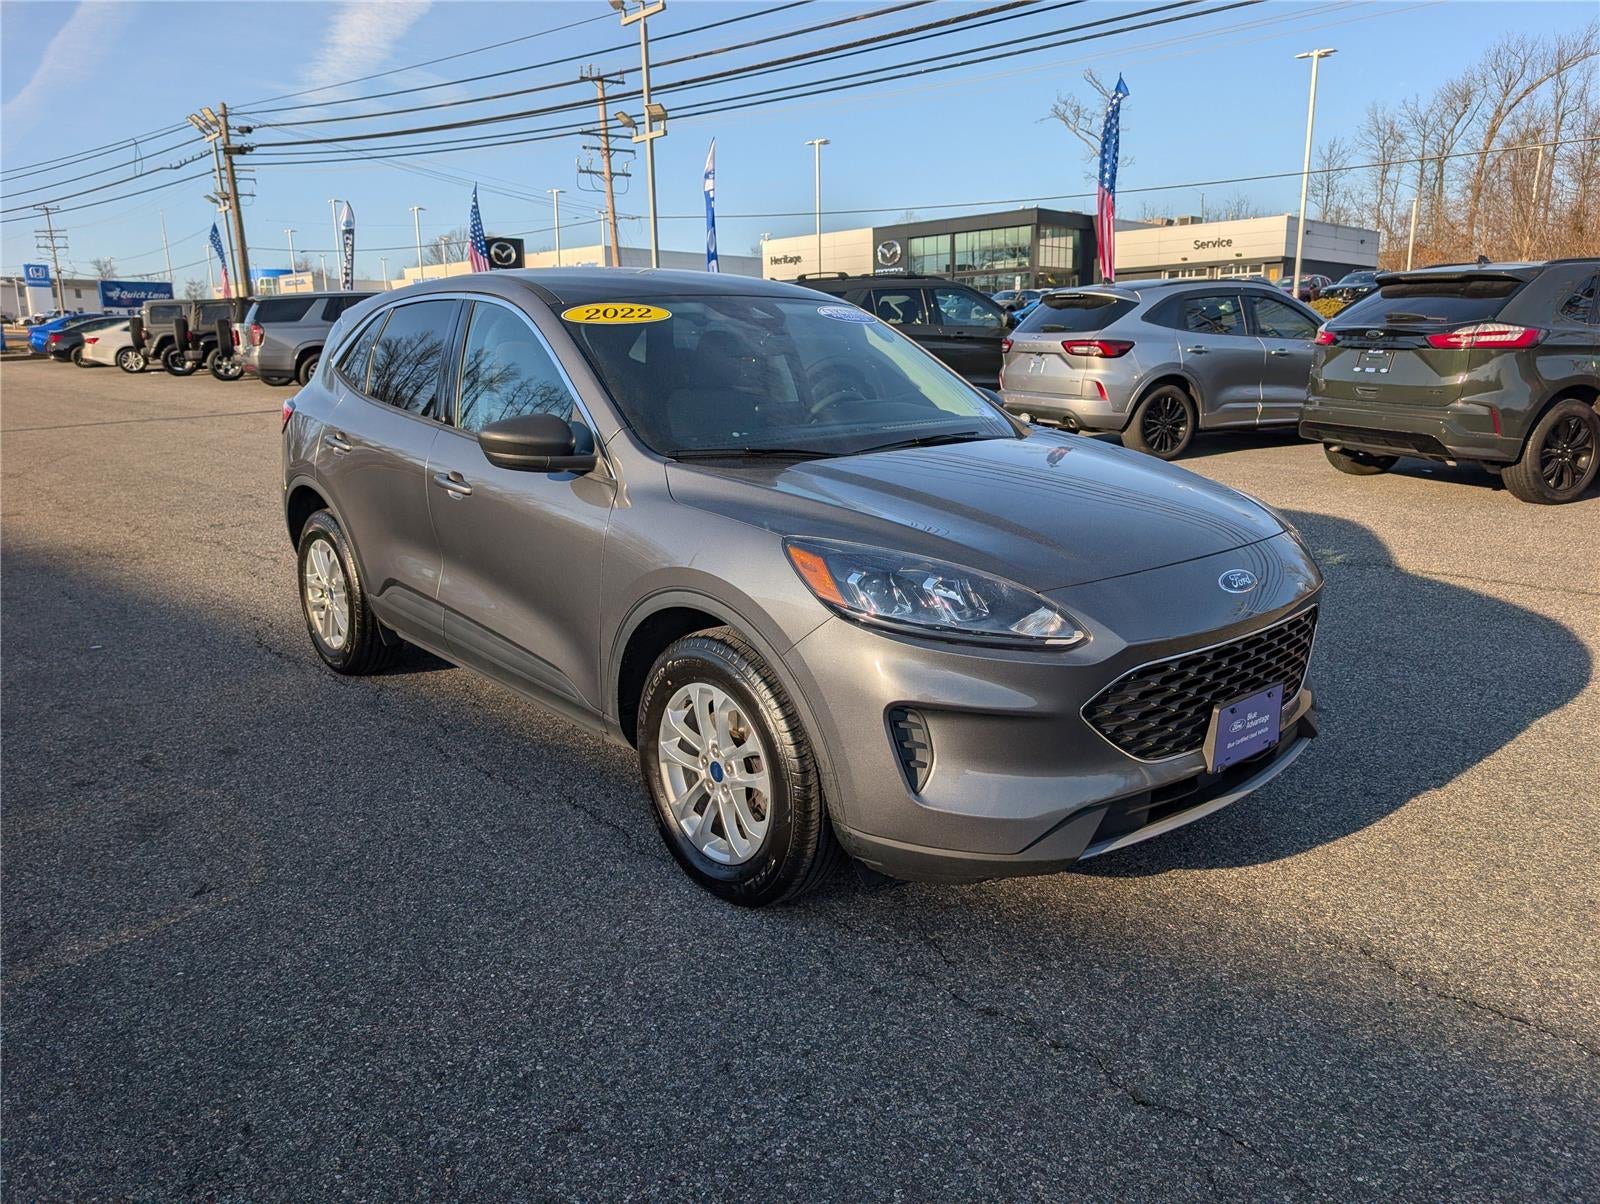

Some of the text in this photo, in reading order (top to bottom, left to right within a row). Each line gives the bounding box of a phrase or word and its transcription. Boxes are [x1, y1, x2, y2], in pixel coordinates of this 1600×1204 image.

[1193, 237, 1233, 250] Service
[770, 254, 802, 266] Heritage
[120, 290, 170, 299] Quick Lane
[584, 307, 652, 321] 2022
[1229, 573, 1252, 588] Ford
[1246, 714, 1269, 728] Advantage
[1247, 712, 1257, 720] Blue
[1231, 720, 1244, 731] Ford
